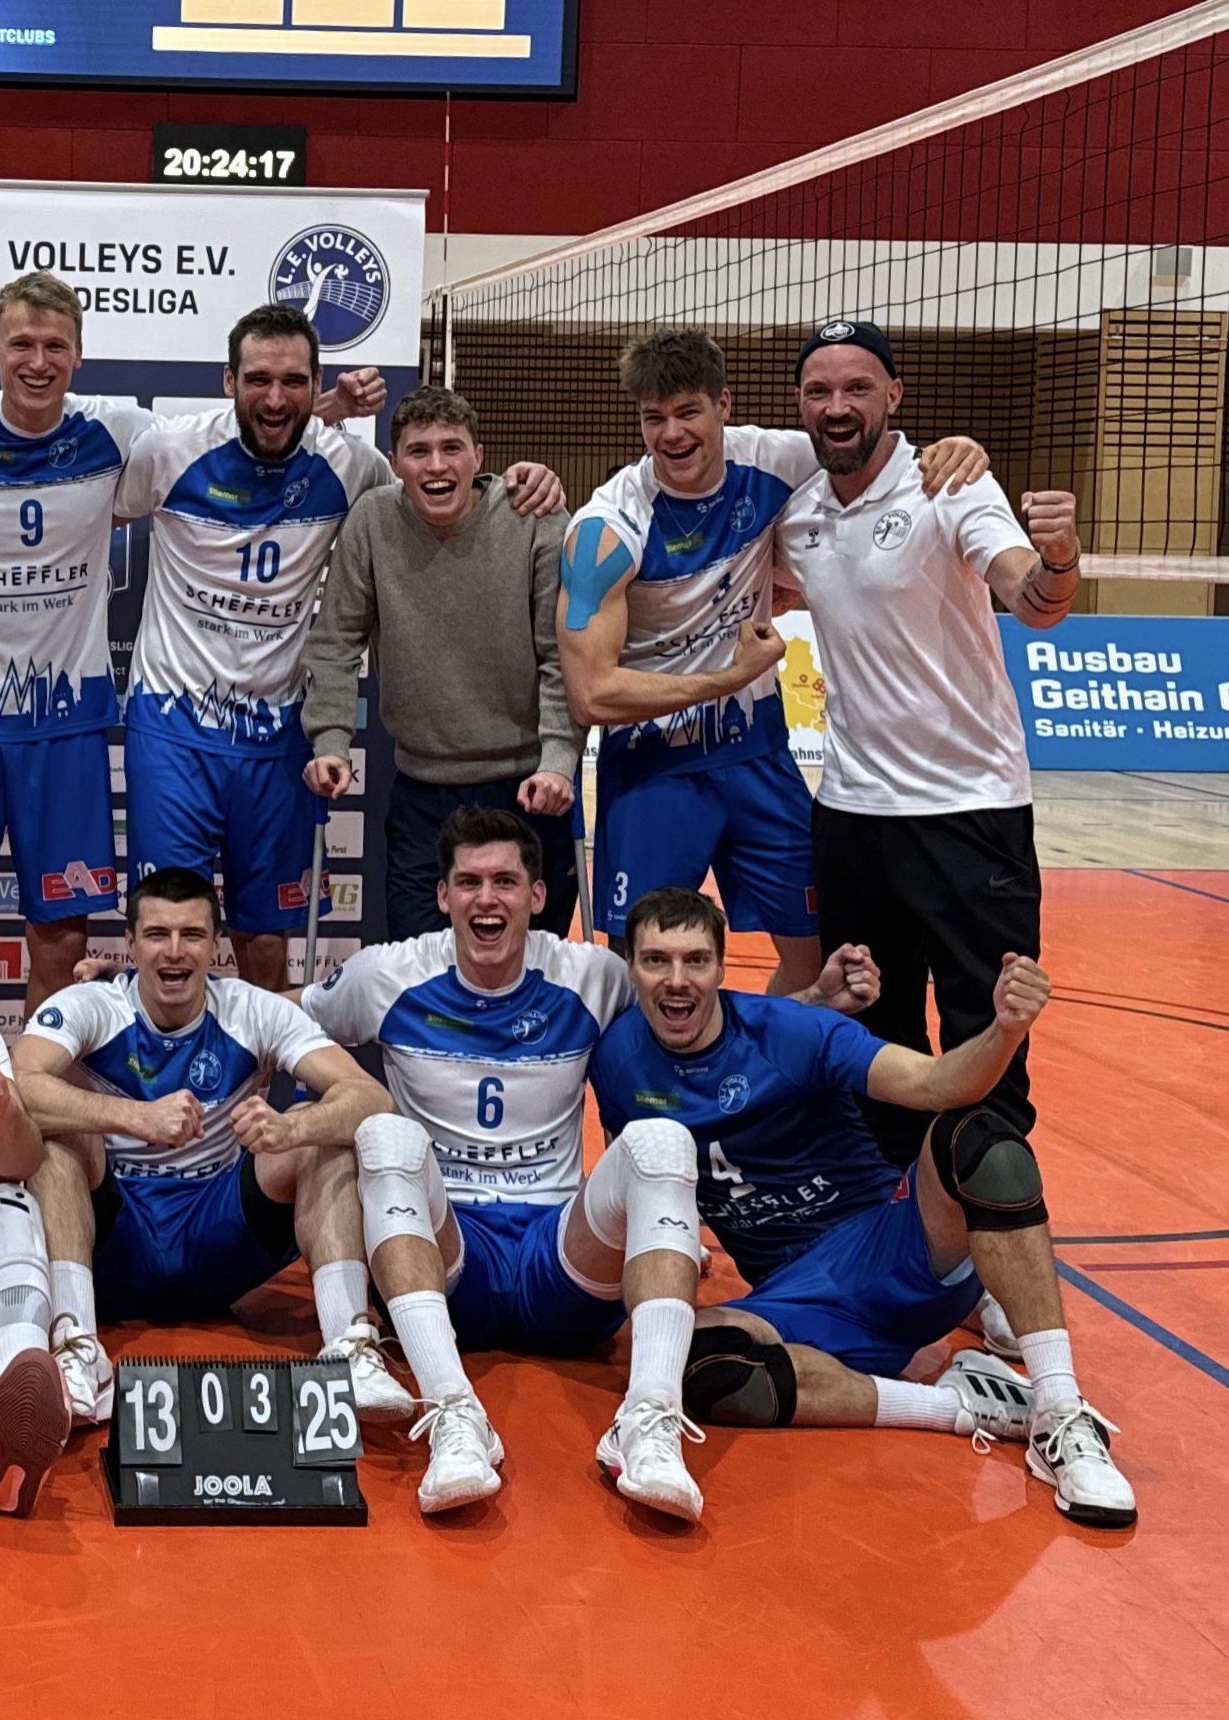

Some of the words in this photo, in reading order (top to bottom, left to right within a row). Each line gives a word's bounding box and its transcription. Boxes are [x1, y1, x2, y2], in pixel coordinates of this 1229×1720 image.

[163, 148, 296, 178] 20:24:17
[8, 240, 163, 274] VOLLEYS
[176, 245, 235, 276] E.V.
[277, 252, 308, 285] L.E.
[304, 232, 382, 284] VOLLEYS
[81, 286, 199, 315] DESLIGA
[20, 499, 44, 547] 9
[236, 540, 281, 584] 10
[22, 600, 40, 613] im
[43, 595, 75, 610] Werk
[186, 585, 303, 618] SCHEFFLER
[197, 618, 231, 635] stark
[233, 627, 250, 639] im
[253, 628, 284, 642] Werk
[1026, 641, 1182, 673] Ausbau
[1031, 678, 1204, 712] Geithain
[1035, 718, 1127, 739] Sanitär
[42, 861, 118, 901] EAD
[613, 871, 628, 906] 3
[477, 1076, 504, 1130] 6
[440, 1167, 473, 1182] stark
[479, 1170, 497, 1184] im
[502, 1169, 542, 1184] Werk
[709, 1140, 757, 1199] 4
[125, 1379, 177, 1452] 13
[201, 1371, 224, 1425] 0
[250, 1373, 271, 1425] 3
[299, 1379, 357, 1451] 25
[194, 1475, 271, 1496] JOOLA
